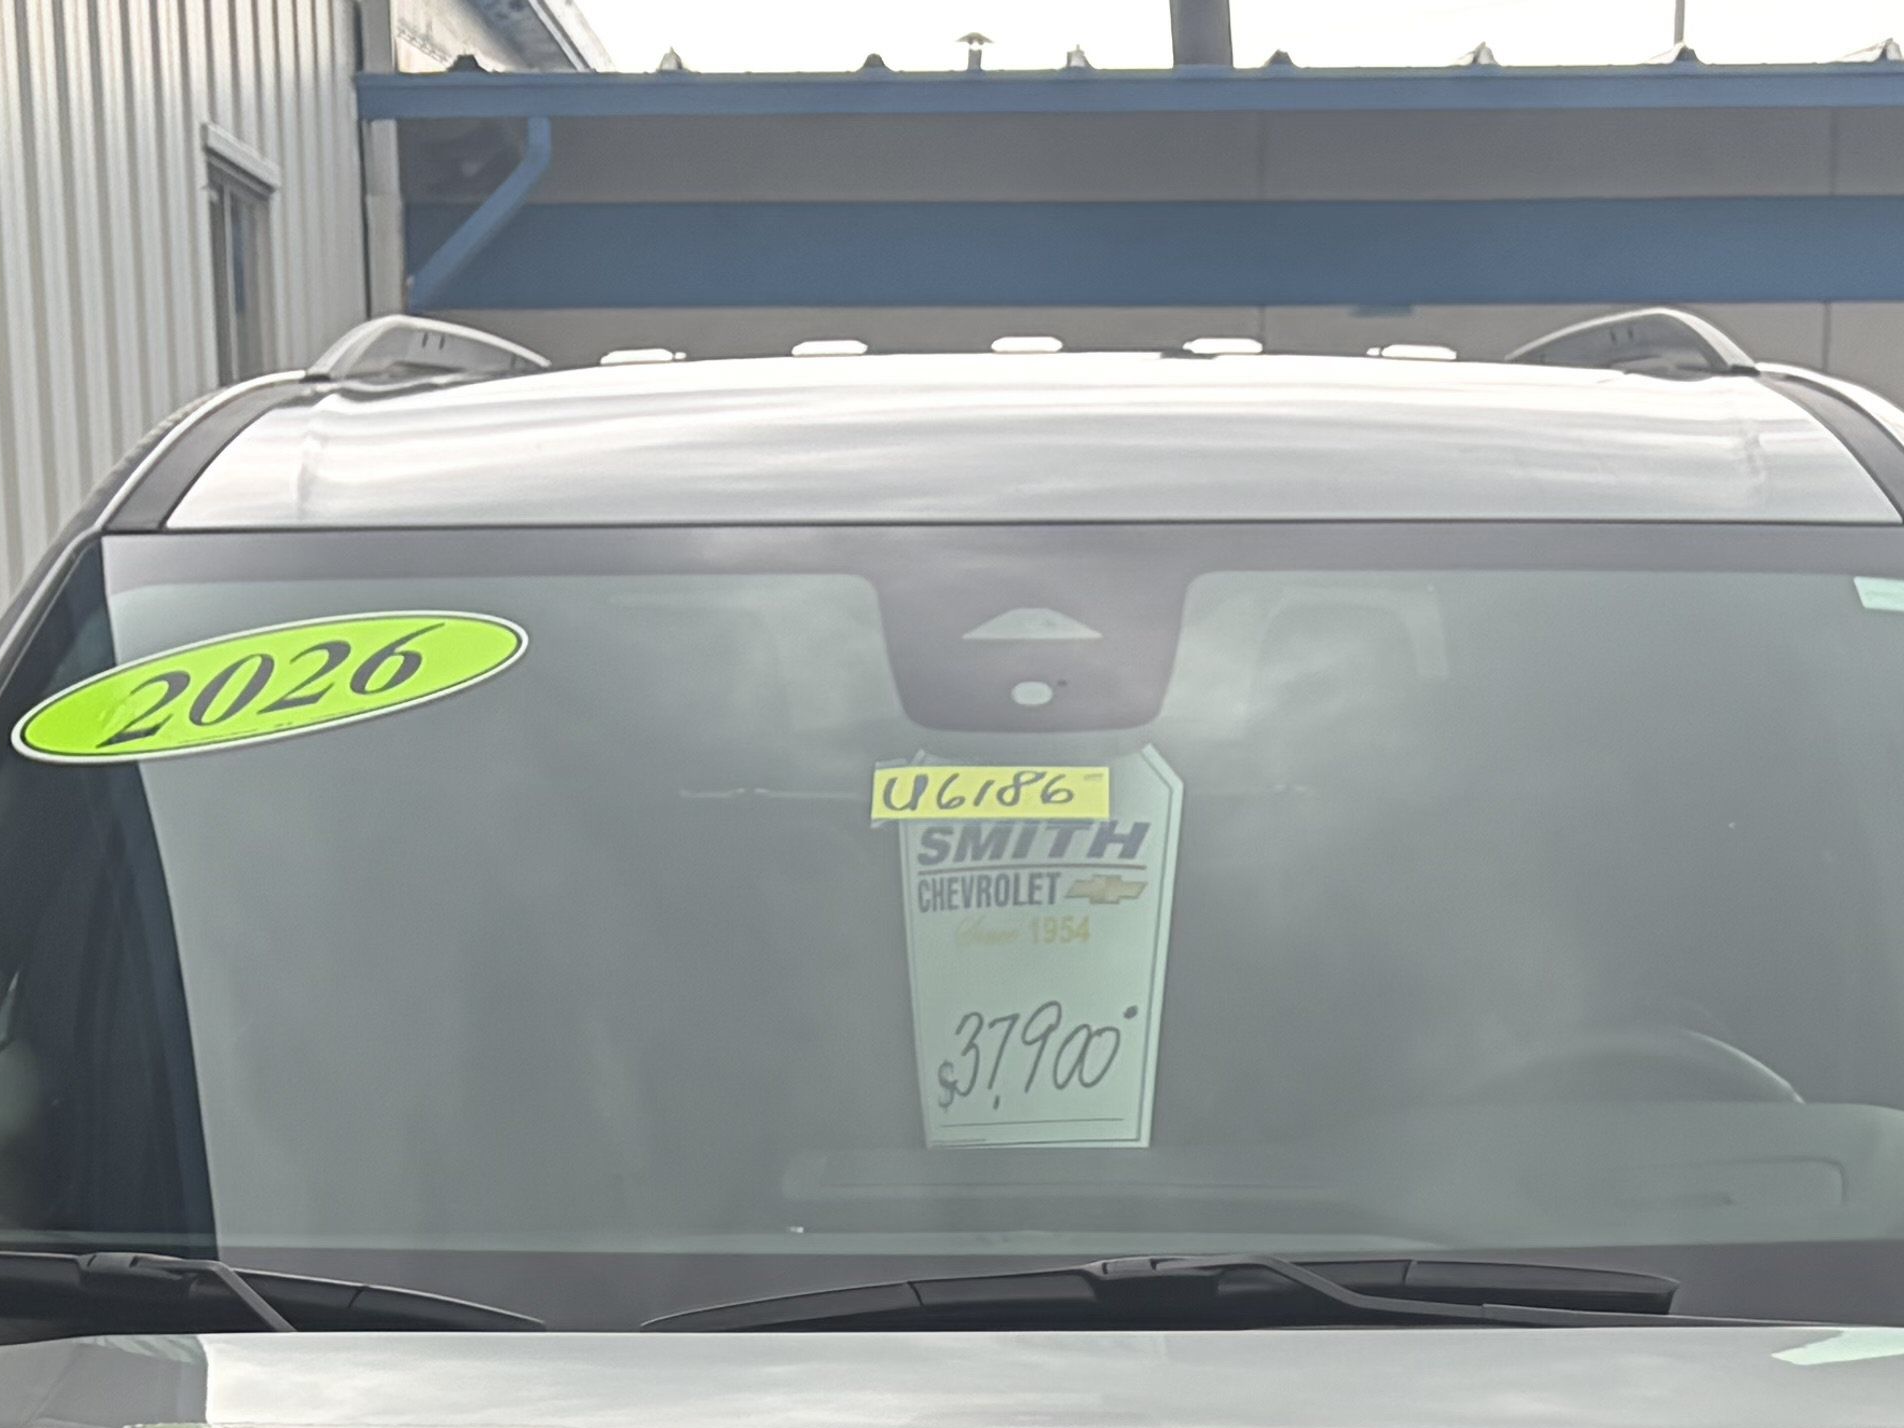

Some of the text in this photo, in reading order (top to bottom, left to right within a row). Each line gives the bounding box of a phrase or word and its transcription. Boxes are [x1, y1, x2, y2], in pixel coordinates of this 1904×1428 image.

[97, 621, 446, 748] 2026
[882, 770, 1074, 811] U6186
[918, 821, 1150, 866] SMITH
[918, 872, 1061, 913] CHEVROLET
[1030, 914, 1090, 944] 1954
